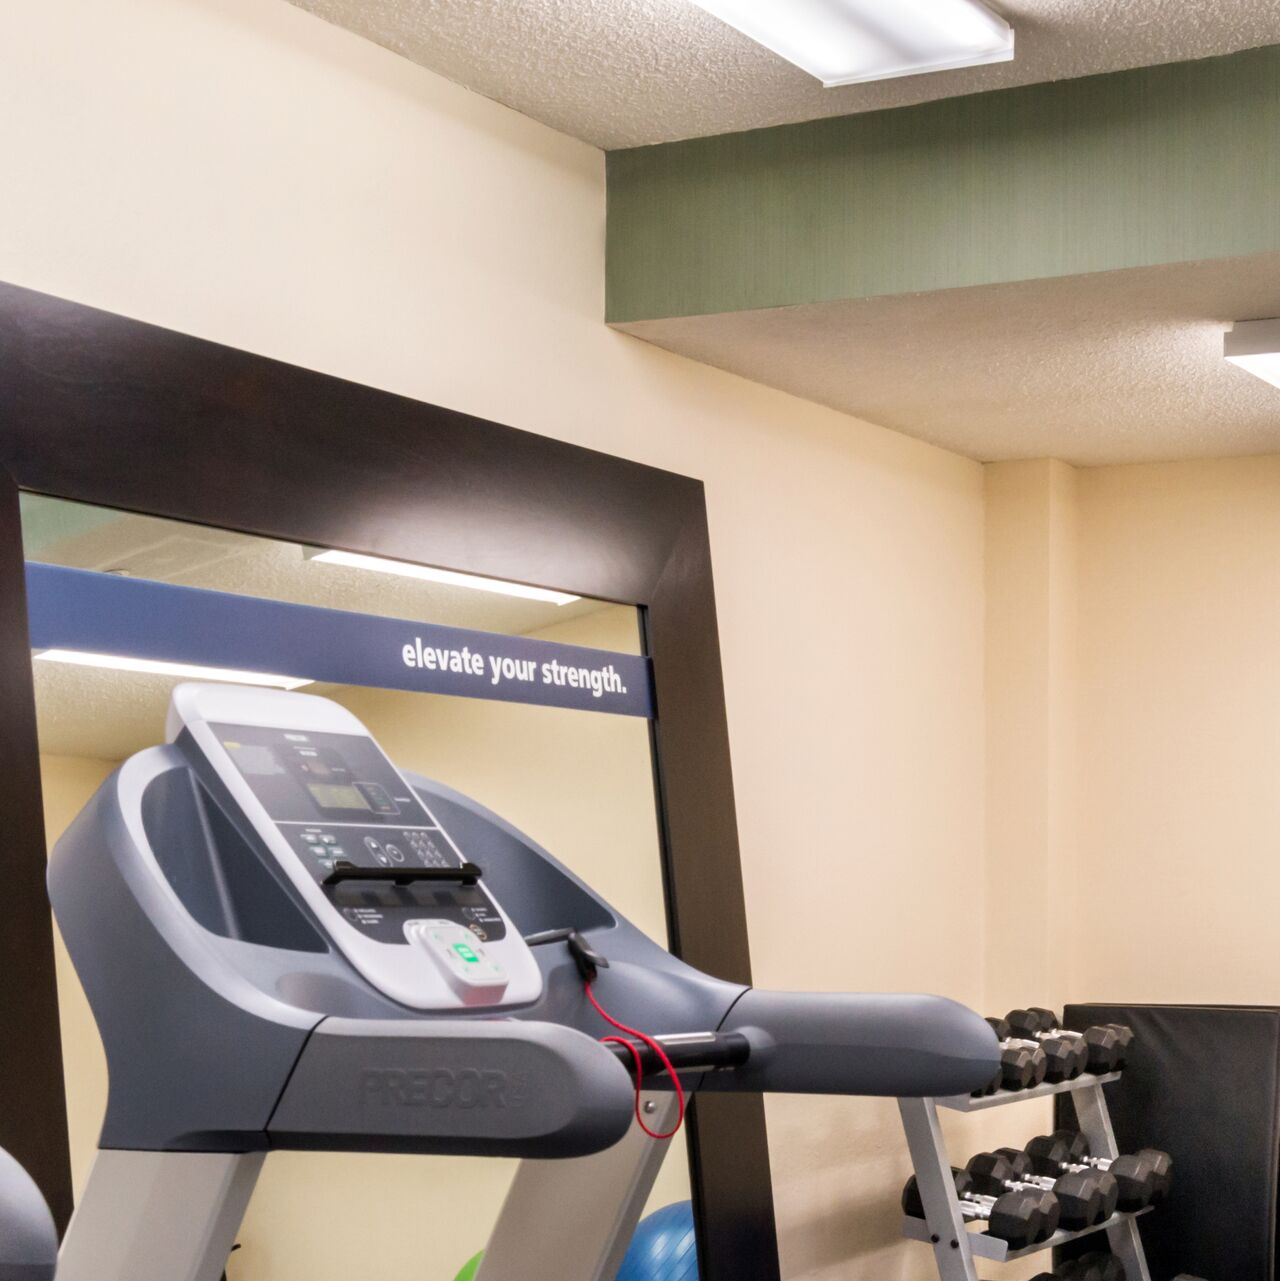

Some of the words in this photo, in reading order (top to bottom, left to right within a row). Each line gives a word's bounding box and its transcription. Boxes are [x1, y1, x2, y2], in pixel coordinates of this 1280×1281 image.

[402, 637, 484, 676] elevate
[489, 655, 536, 685] your
[542, 659, 627, 698] strength.
[361, 1066, 510, 1109] PRECOR
